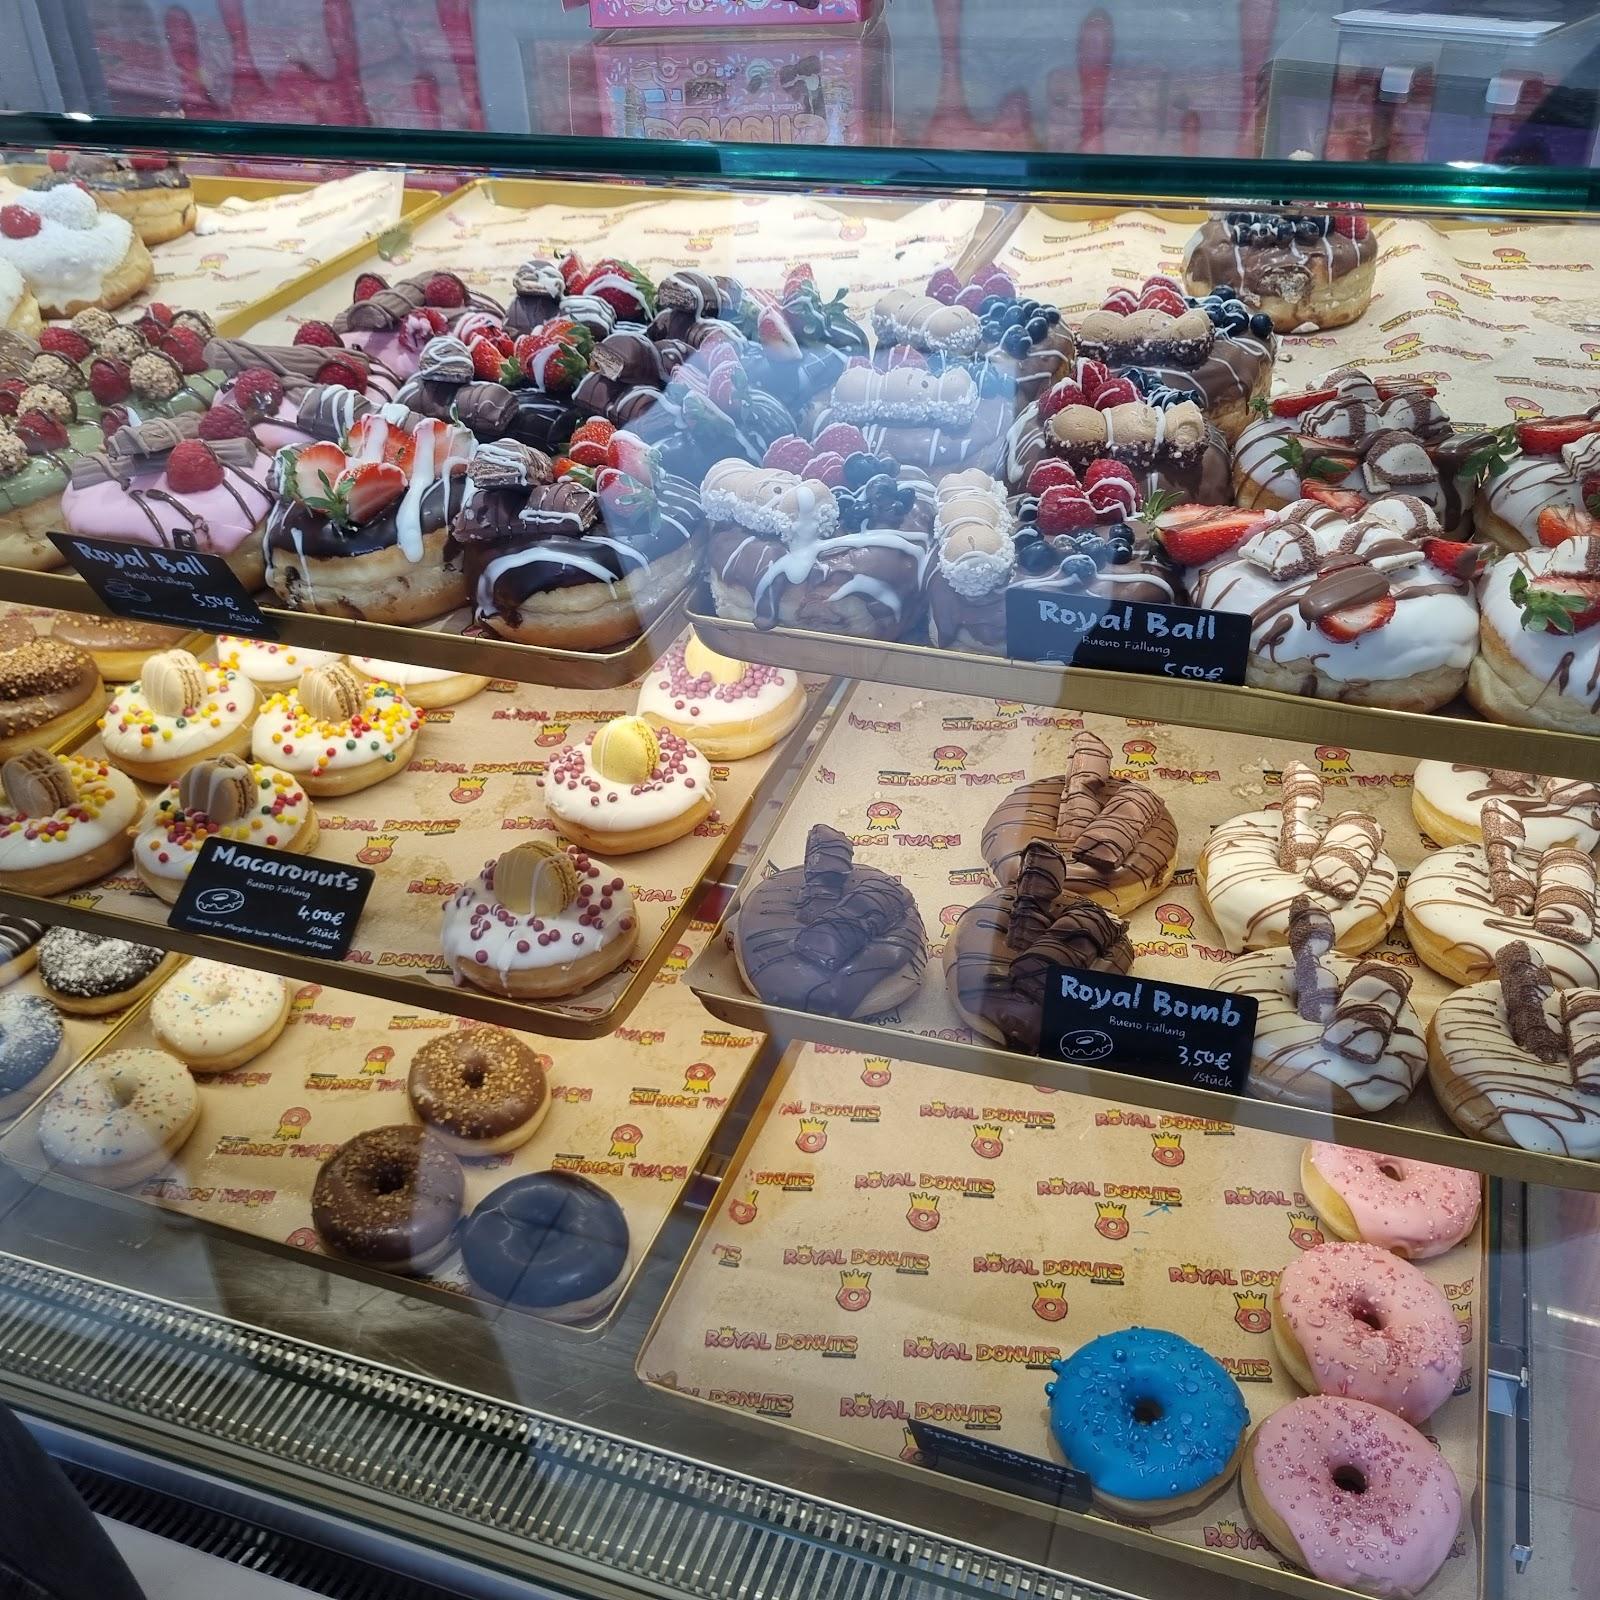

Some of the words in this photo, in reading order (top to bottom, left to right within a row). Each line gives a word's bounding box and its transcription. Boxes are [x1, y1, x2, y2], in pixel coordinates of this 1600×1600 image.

[73, 542, 149, 569] Royal
[151, 552, 210, 576] Ball
[1038, 600, 1133, 632] Royal
[1146, 612, 1215, 640] Ball
[1082, 636, 1120, 648] Bueno
[1124, 640, 1171, 657] Füllung
[942, 719, 1017, 731] DONUTS
[1021, 715, 1083, 729] ROYAL
[407, 761, 468, 773] ROYAL
[472, 761, 548, 774] DONUTS
[1153, 768, 1221, 782] ROYAL
[877, 773, 956, 785] DONUTS
[960, 770, 1025, 785] ROYAL
[318, 818, 378, 832] ROYAL
[382, 819, 461, 832] DONUTS
[895, 834, 961, 847] ROYAL
[211, 845, 359, 891] Macaronuts
[276, 884, 311, 900] Füllung
[298, 905, 345, 926] 4,00€
[307, 927, 341, 940] /Stück
[1061, 975, 1143, 1010] Royal
[1153, 989, 1241, 1028] Bomb
[304, 1013, 356, 1028] ROYAL
[1109, 1016, 1142, 1029] Bueno
[1146, 1022, 1186, 1039] Füllung
[1177, 1045, 1232, 1071] 3,50€
[1193, 1072, 1233, 1088] /Stück
[629, 1092, 699, 1108] DONUTS
[810, 1101, 881, 1117] DONUTS
[919, 1104, 979, 1120] ROYAL
[982, 1107, 1056, 1124] DONUTS
[1095, 1112, 1156, 1128] ROYAL
[1159, 1115, 1235, 1131] DONUTS
[628, 1163, 688, 1179] ROYAL
[855, 1172, 916, 1189] ROYAL
[919, 1173, 995, 1192] DONUTS
[1037, 1180, 1100, 1196] ROYAL
[1104, 1183, 1182, 1201] DONUTS
[1224, 1189, 1291, 1206] ROYAL
[783, 1248, 847, 1265] ROYAL
[851, 1248, 930, 1270] DONUTS
[974, 1257, 1039, 1276] ROYAL
[1043, 1259, 1125, 1280] DONUTS
[1168, 1266, 1238, 1285] ROYAL
[705, 1329, 772, 1350] ROYAL
[775, 1333, 858, 1352] DONUTS
[904, 1339, 972, 1361] ROYAL
[976, 1344, 1062, 1364] DONUTS
[710, 1390, 794, 1410] DONUTS
[840, 1396, 910, 1420] ROYAL
[915, 1401, 1002, 1424] DONUTS
